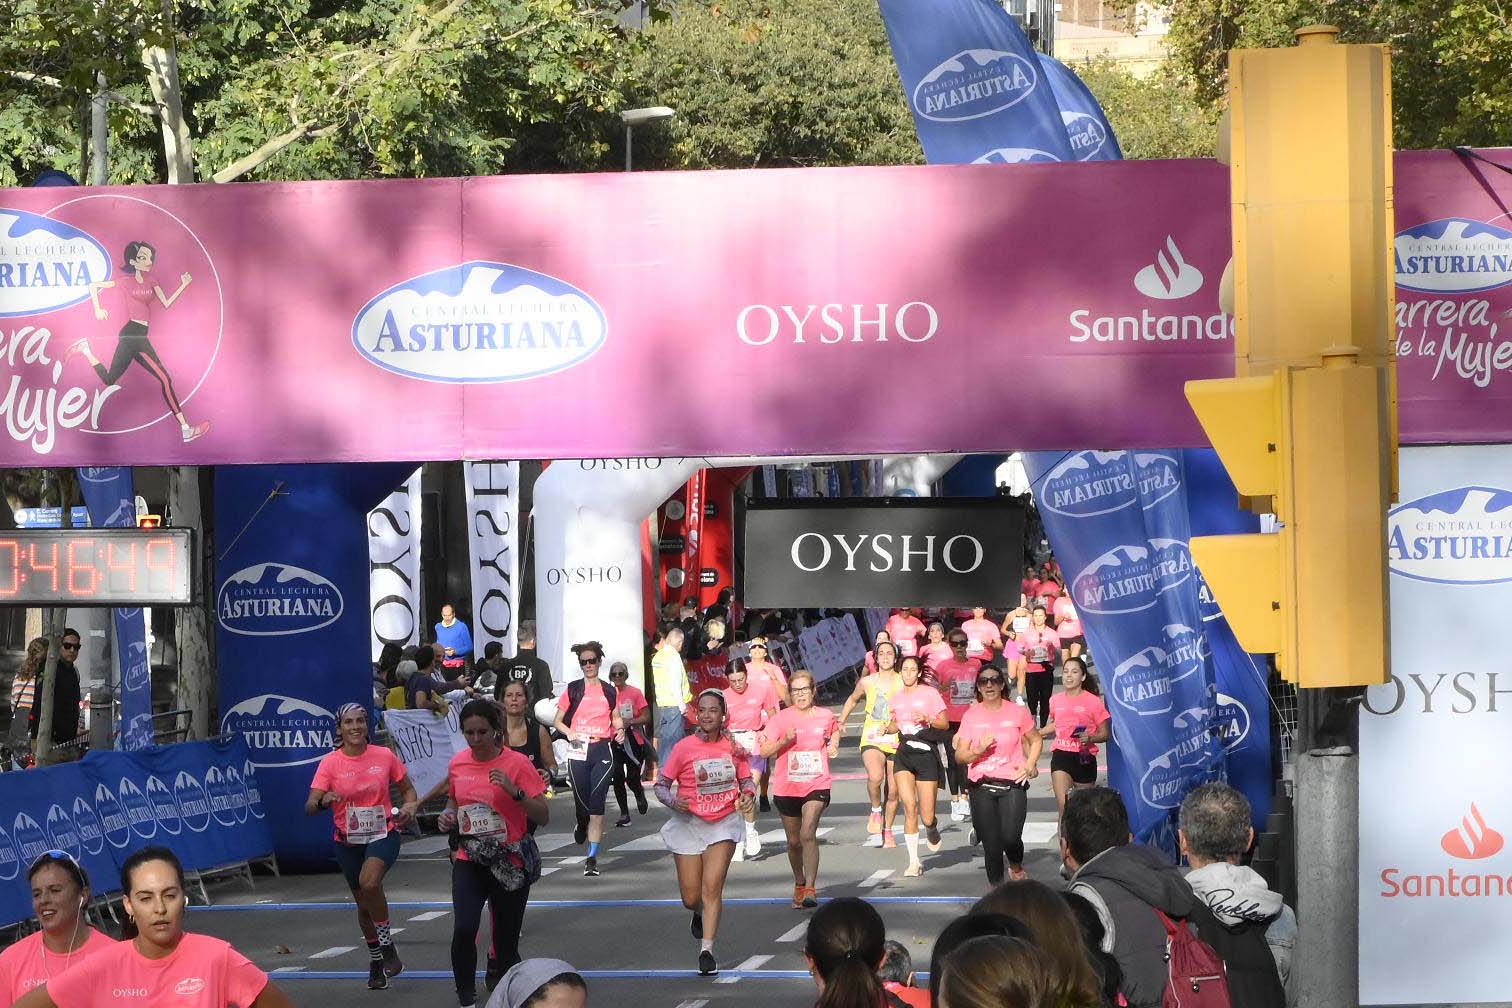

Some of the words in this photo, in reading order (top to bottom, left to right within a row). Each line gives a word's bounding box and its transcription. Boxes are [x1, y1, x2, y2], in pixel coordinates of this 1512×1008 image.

[14, 244, 87, 256] LECHERA
[736, 301, 939, 346] OYSHO
[1395, 299, 1490, 328] arrera
[372, 308, 586, 353] ASTURIANA
[1418, 330, 1436, 357] la
[1432, 326, 1512, 389] Muje
[1415, 520, 1480, 531] CENTRAL
[790, 532, 983, 574] OYSHO
[546, 565, 622, 586] OYSHO
[234, 587, 277, 596] CENTRAL
[281, 587, 330, 596] LECHERA
[221, 592, 335, 620] ASTURIANA
[514, 670, 527, 679] BP
[235, 719, 277, 728] CENTRAL
[281, 719, 331, 728] LECHERA
[113, 987, 148, 998] OYSHO
